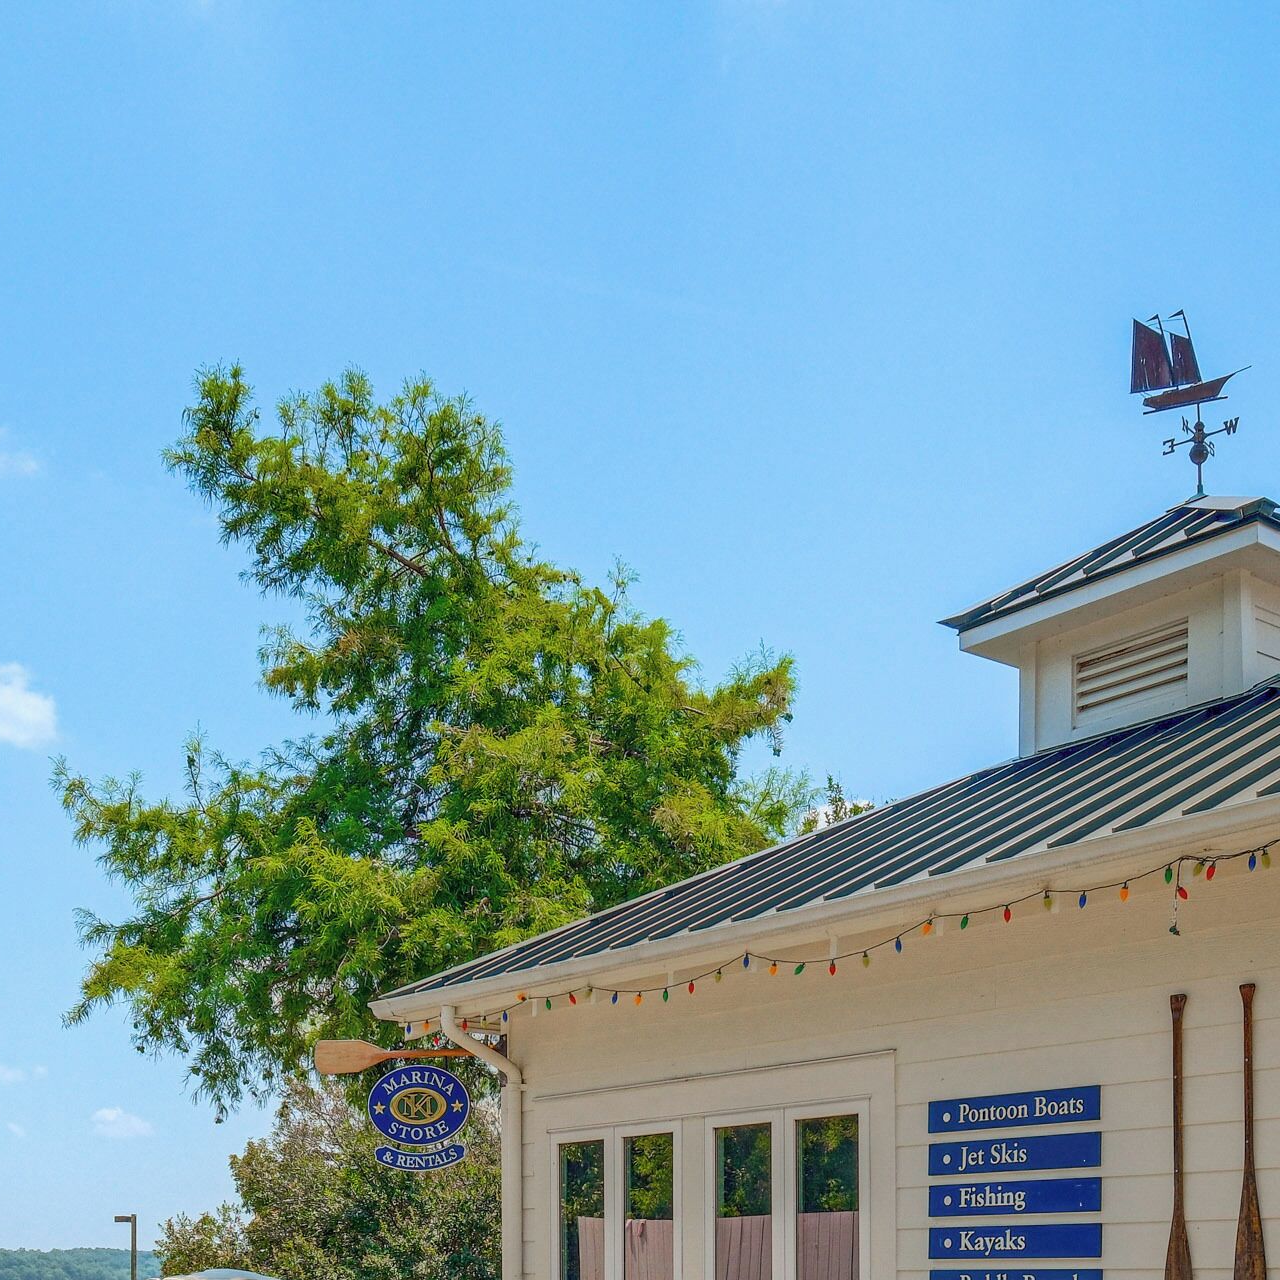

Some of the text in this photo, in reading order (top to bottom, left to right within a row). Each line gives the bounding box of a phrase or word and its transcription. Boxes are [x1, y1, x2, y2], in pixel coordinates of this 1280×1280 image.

[381, 1071, 455, 1096] MARINA
[958, 1096, 1084, 1123] Pontoon Boats
[388, 1120, 449, 1140] STORE
[382, 1148, 458, 1168] & RENTALS
[958, 1142, 1027, 1171] Jet Skis
[958, 1185, 1026, 1211] Fishing
[959, 1229, 1026, 1256] Kayaks
